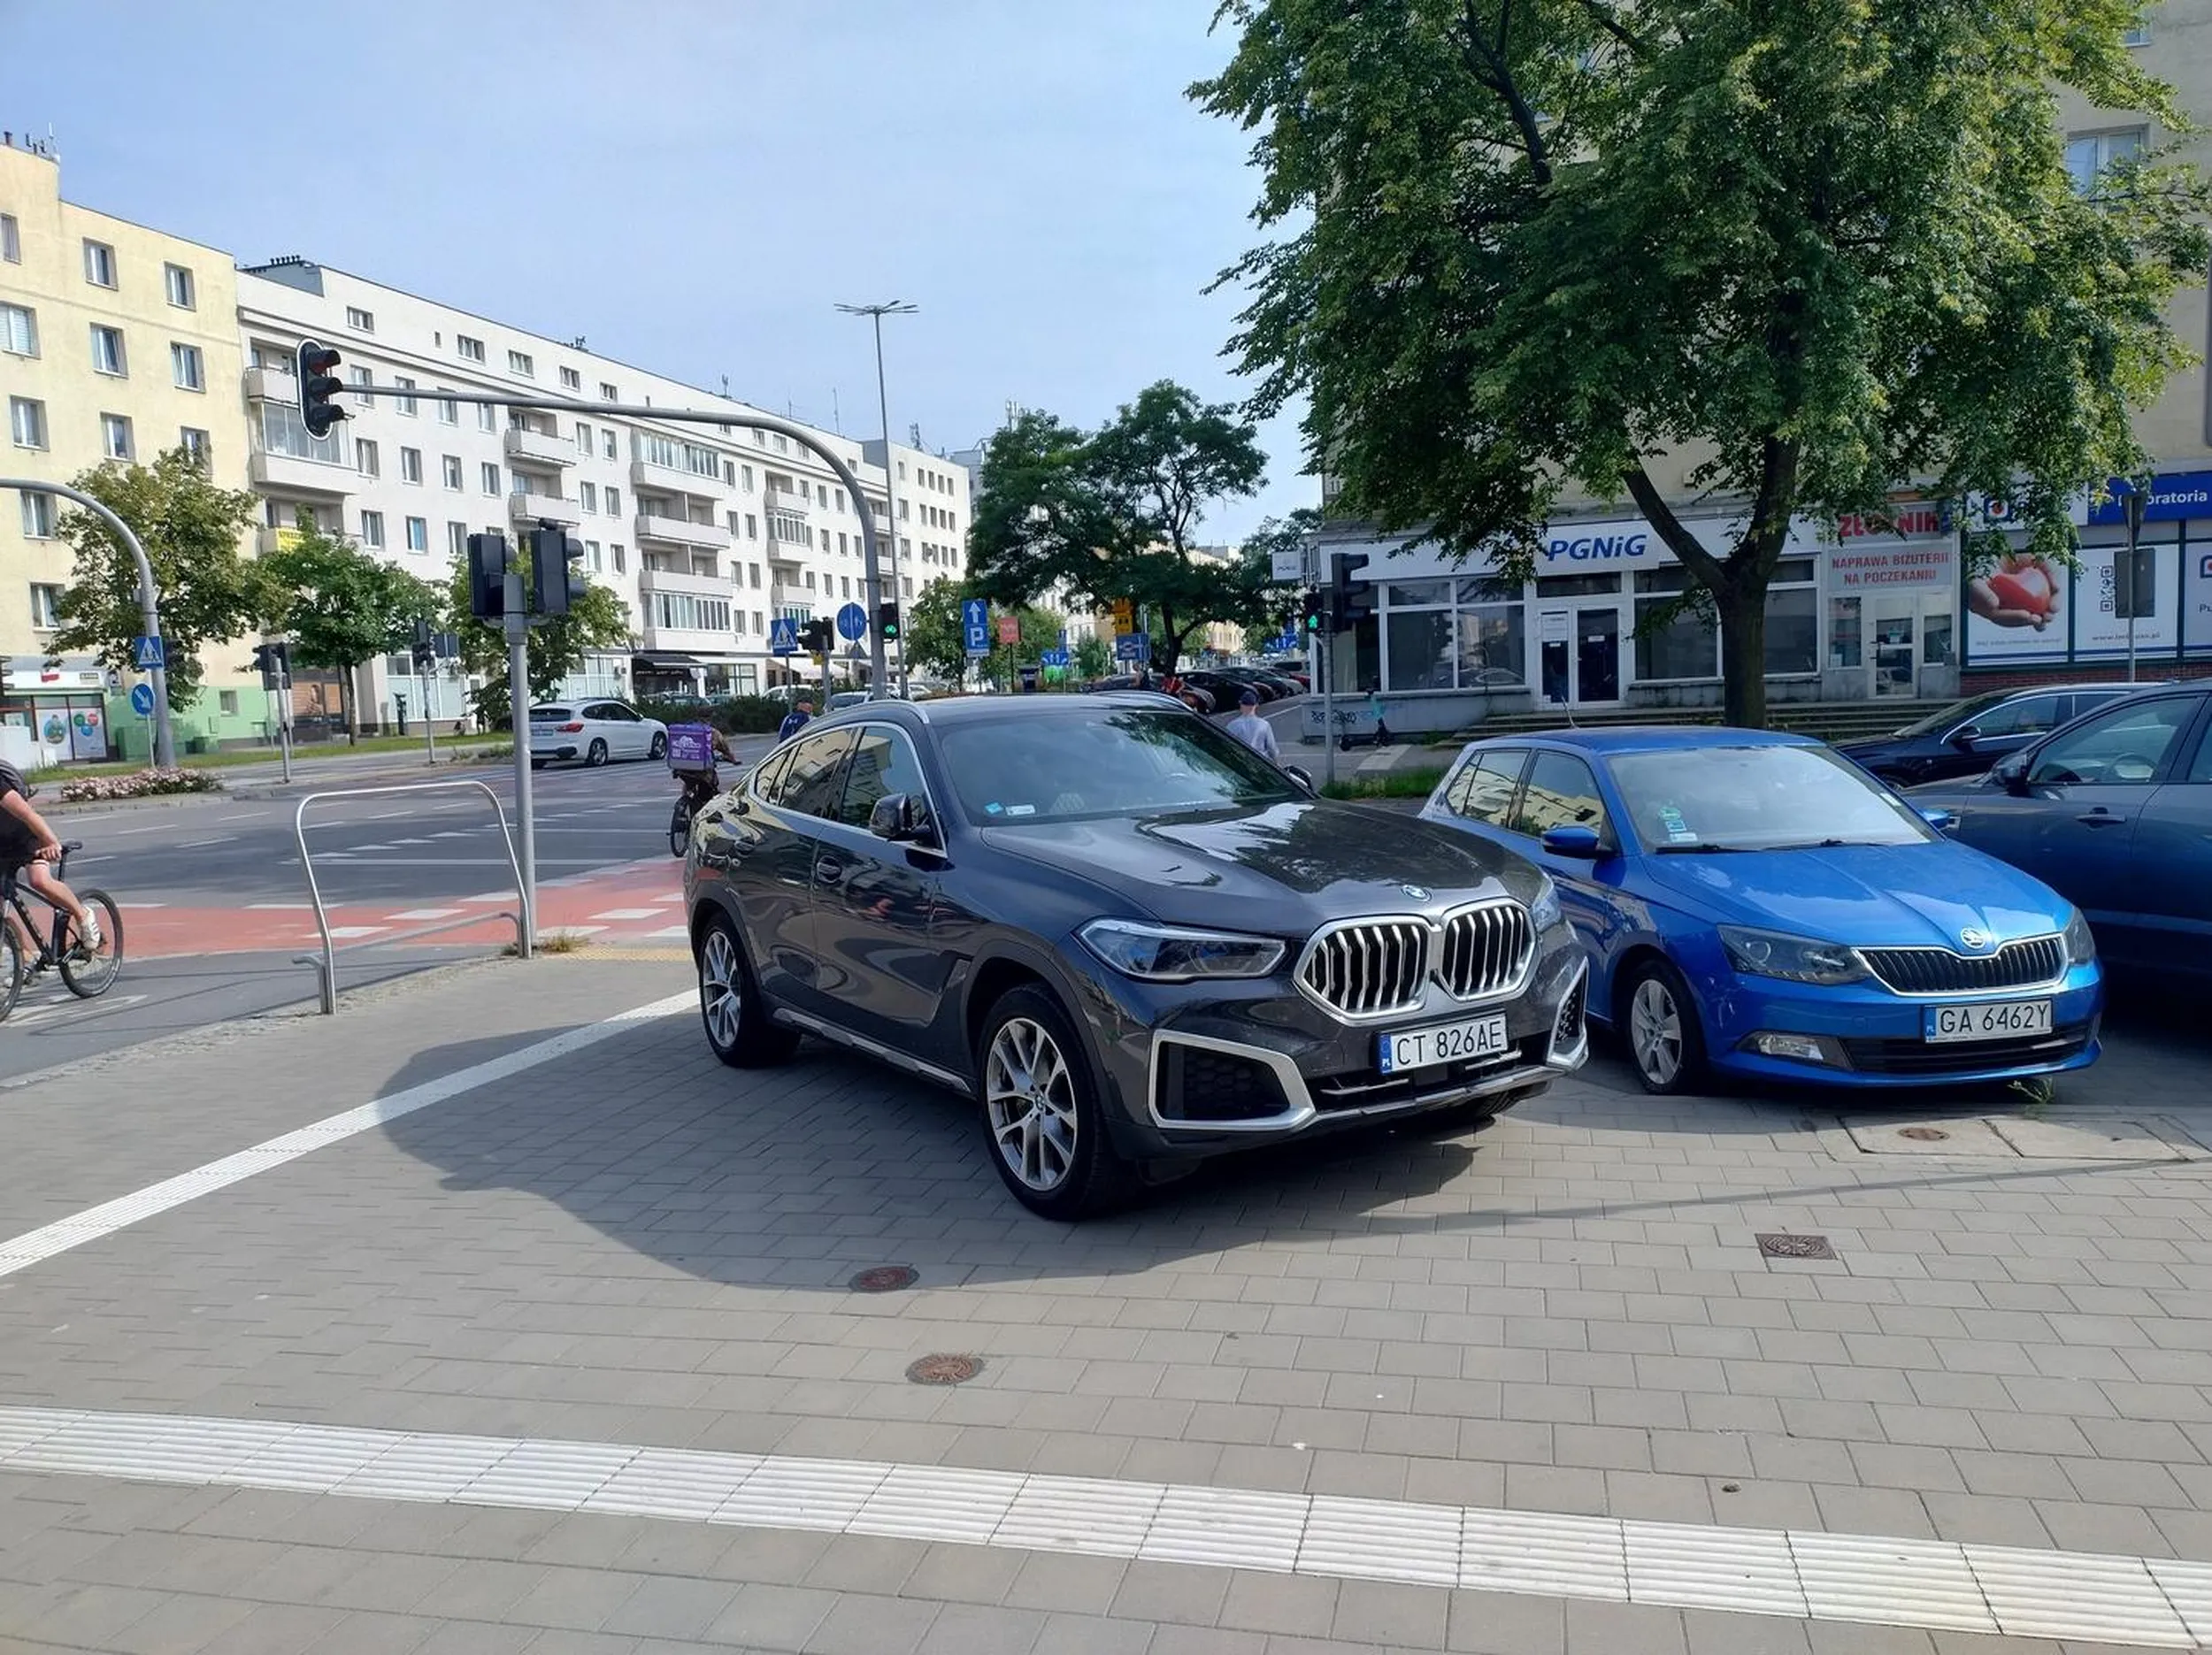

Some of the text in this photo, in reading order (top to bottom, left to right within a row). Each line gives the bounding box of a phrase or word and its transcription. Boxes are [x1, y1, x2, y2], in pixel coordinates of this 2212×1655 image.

[1548, 534, 1647, 561] PGNiG
[1832, 555, 1888, 569] NAPRAWA
[1844, 569, 1937, 585] NA POCZEKANIU
[970, 626, 984, 647] P
[1940, 1003, 2049, 1033] GA 6462Y
[1396, 1021, 1502, 1065] CT 826AE
